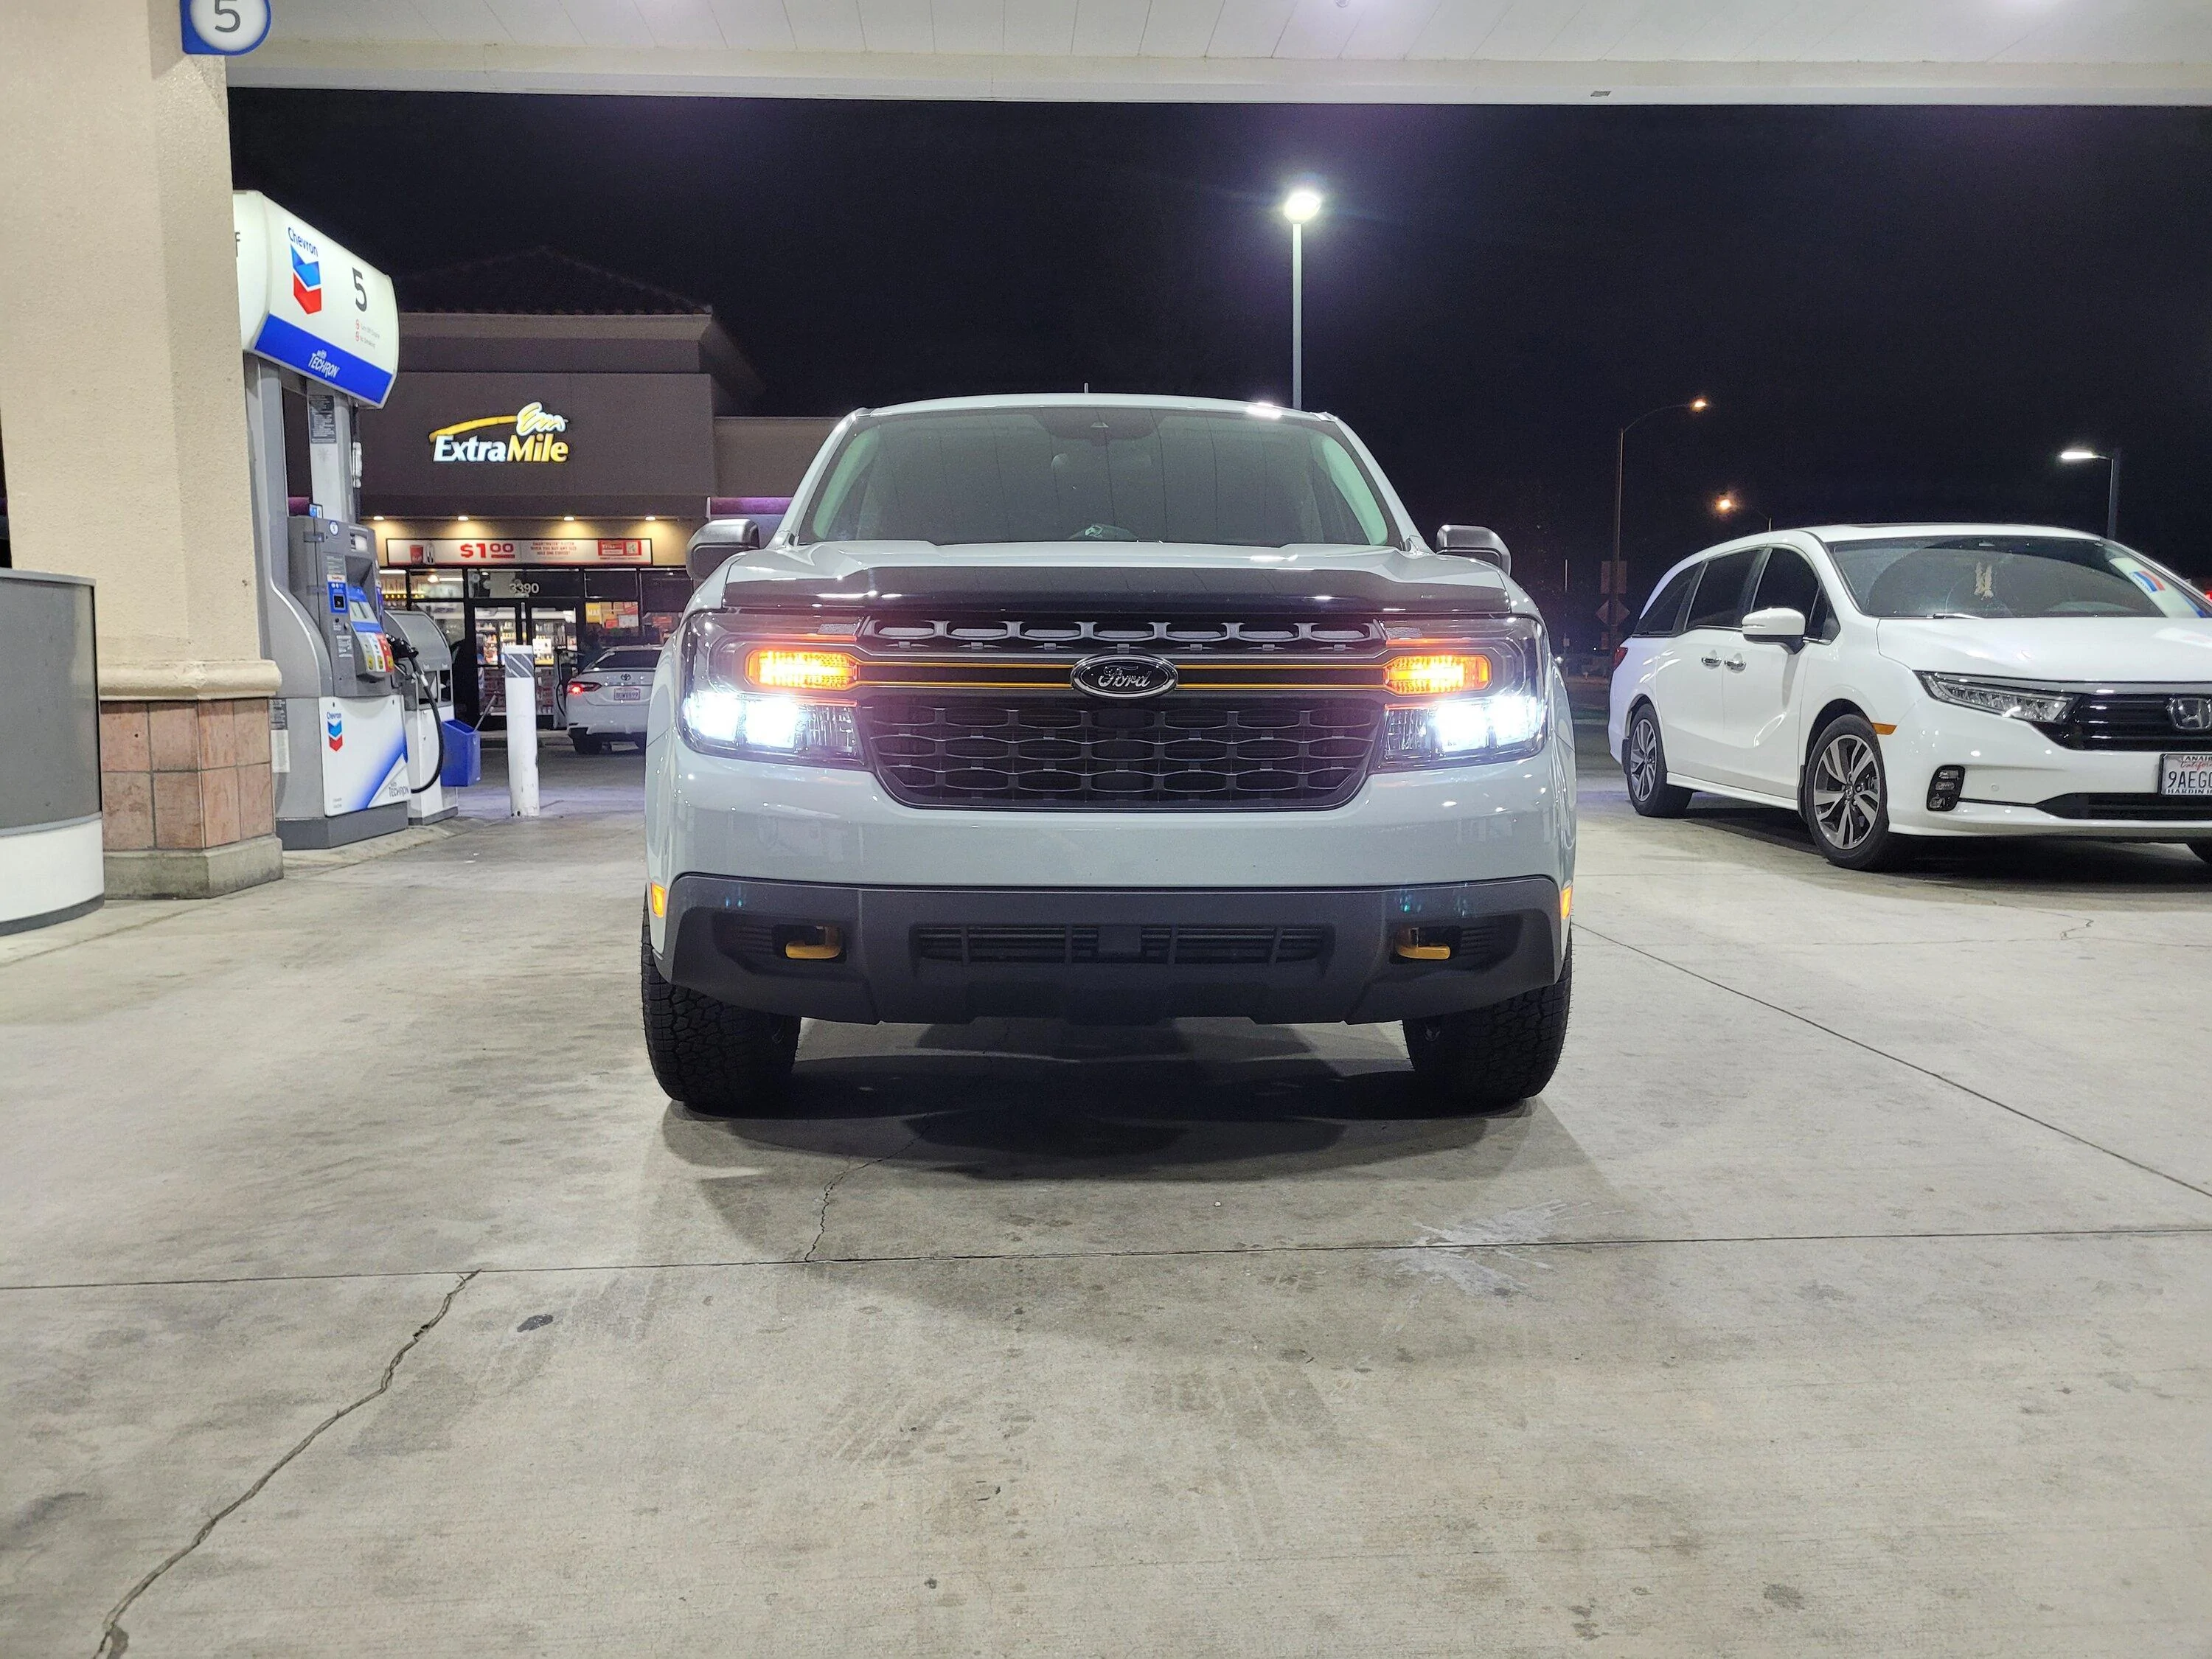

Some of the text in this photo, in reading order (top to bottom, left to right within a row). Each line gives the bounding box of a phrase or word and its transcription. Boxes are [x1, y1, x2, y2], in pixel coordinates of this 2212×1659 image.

[215, 0, 240, 33] 5
[288, 226, 319, 258] Chevron
[352, 266, 368, 313] 5
[307, 352, 340, 378] TECHRON
[433, 433, 569, 462] ExtraMile
[509, 582, 540, 594] 3390
[1097, 665, 1152, 688] Ford
[326, 711, 342, 720] Chevron
[388, 785, 409, 798] TECHRON
